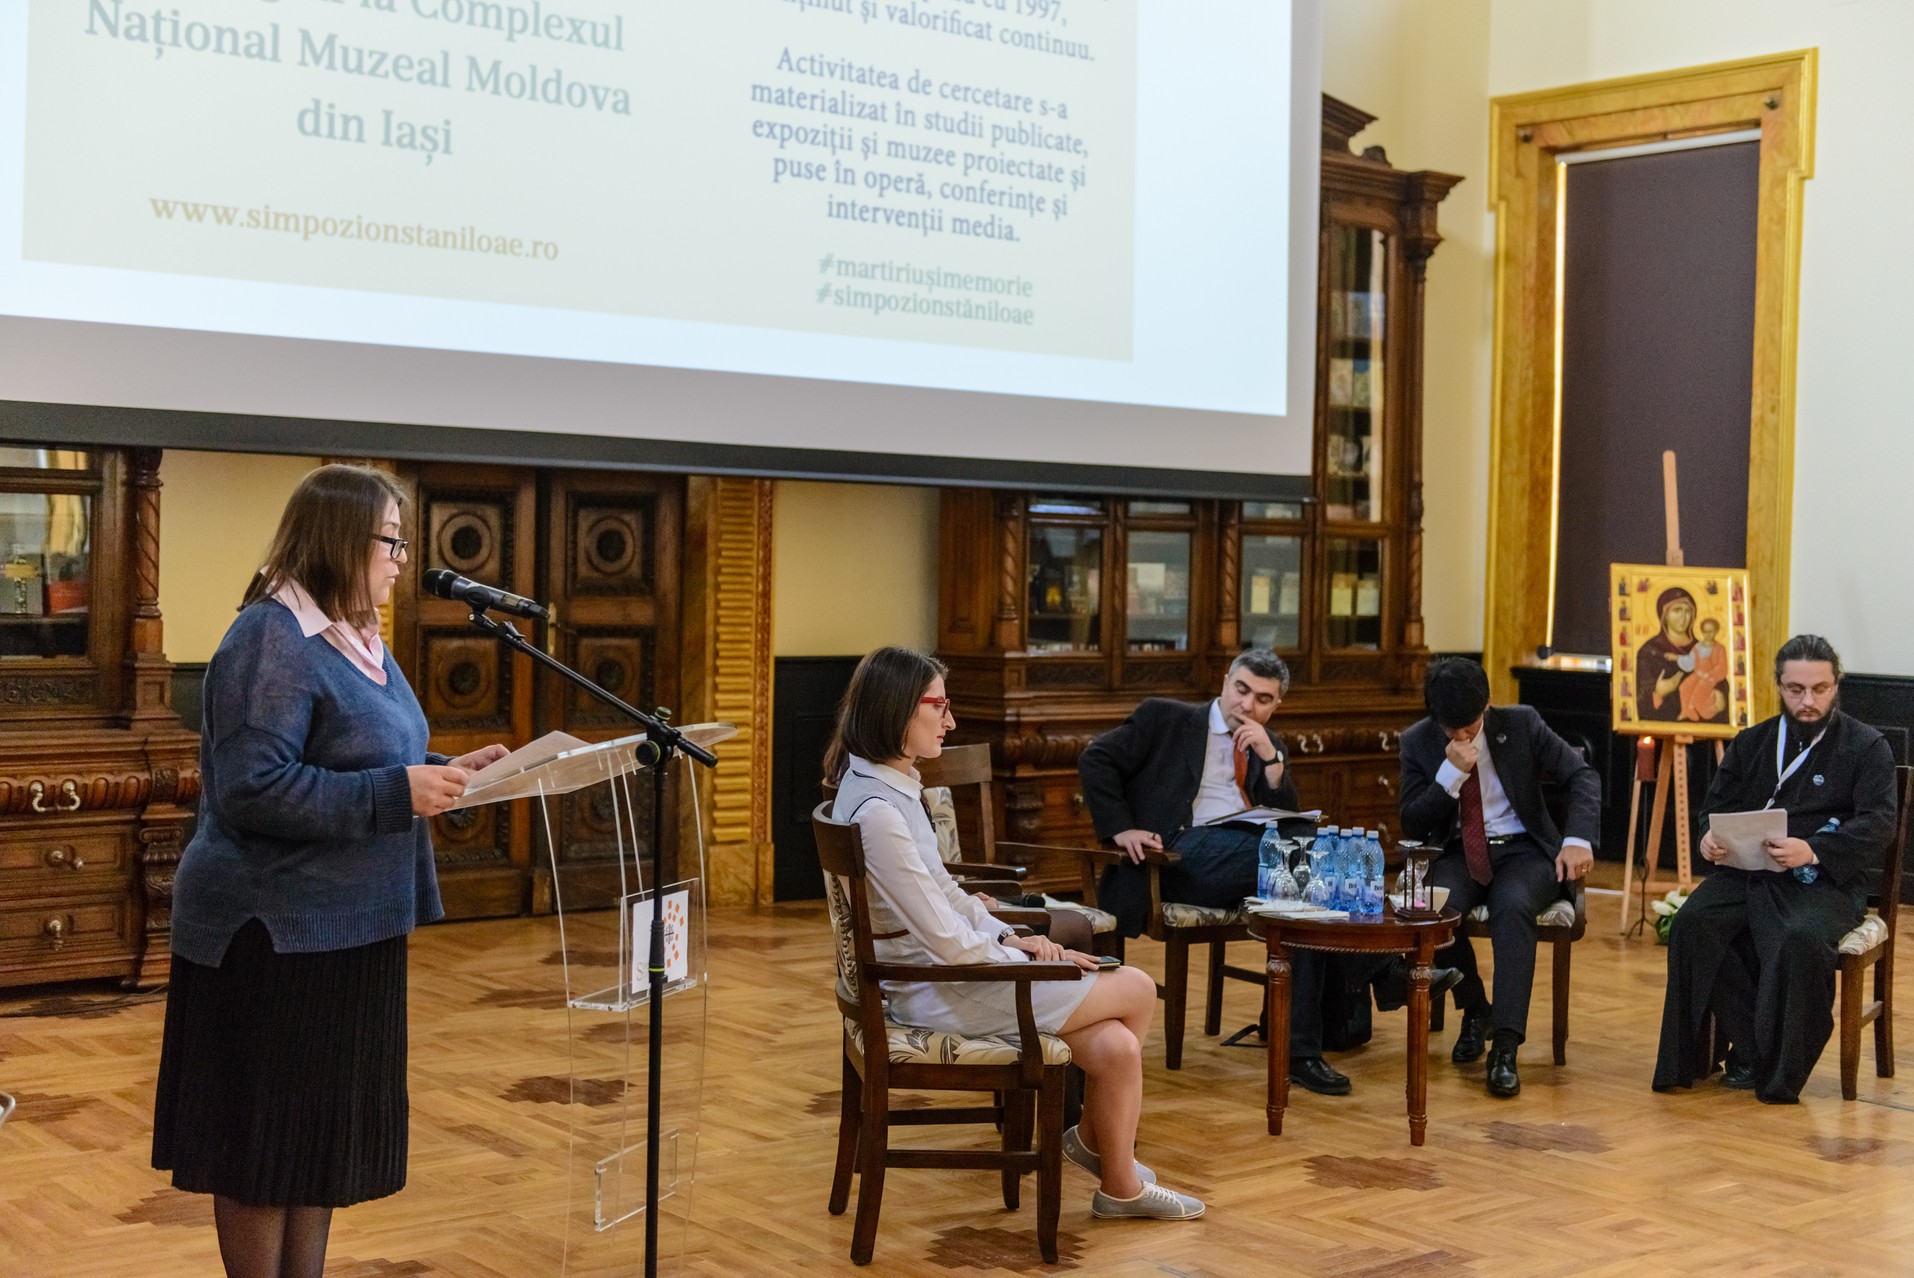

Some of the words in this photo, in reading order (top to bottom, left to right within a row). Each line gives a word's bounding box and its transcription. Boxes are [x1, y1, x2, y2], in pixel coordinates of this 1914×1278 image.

[411, 0, 625, 51] Complexul
[885, 1, 993, 42] valorificat
[999, 28, 1095, 61] continuu.
[85, 0, 283, 63] Național
[297, 28, 452, 89] Muzeal
[465, 55, 633, 117] Moldova
[776, 47, 901, 91] Activitatea
[907, 69, 933, 96] de
[939, 82, 1034, 113] cercetare
[1039, 100, 1069, 120] s-a
[297, 98, 367, 144] din
[381, 109, 454, 167] Iași
[751, 84, 889, 123] materializat
[895, 101, 917, 127] în
[924, 111, 985, 138] studii
[991, 120, 1089, 158] publicate,
[773, 157, 827, 184] puse
[834, 159, 856, 186] în
[863, 171, 933, 200] operă,
[886, 141, 956, 167] muzee
[963, 152, 1064, 183] proiectate
[149, 198, 559, 261] www.simpozionstaniloae.ro
[951, 214, 1021, 242] media.
[817, 283, 1034, 325] #simpozionstăniloae
